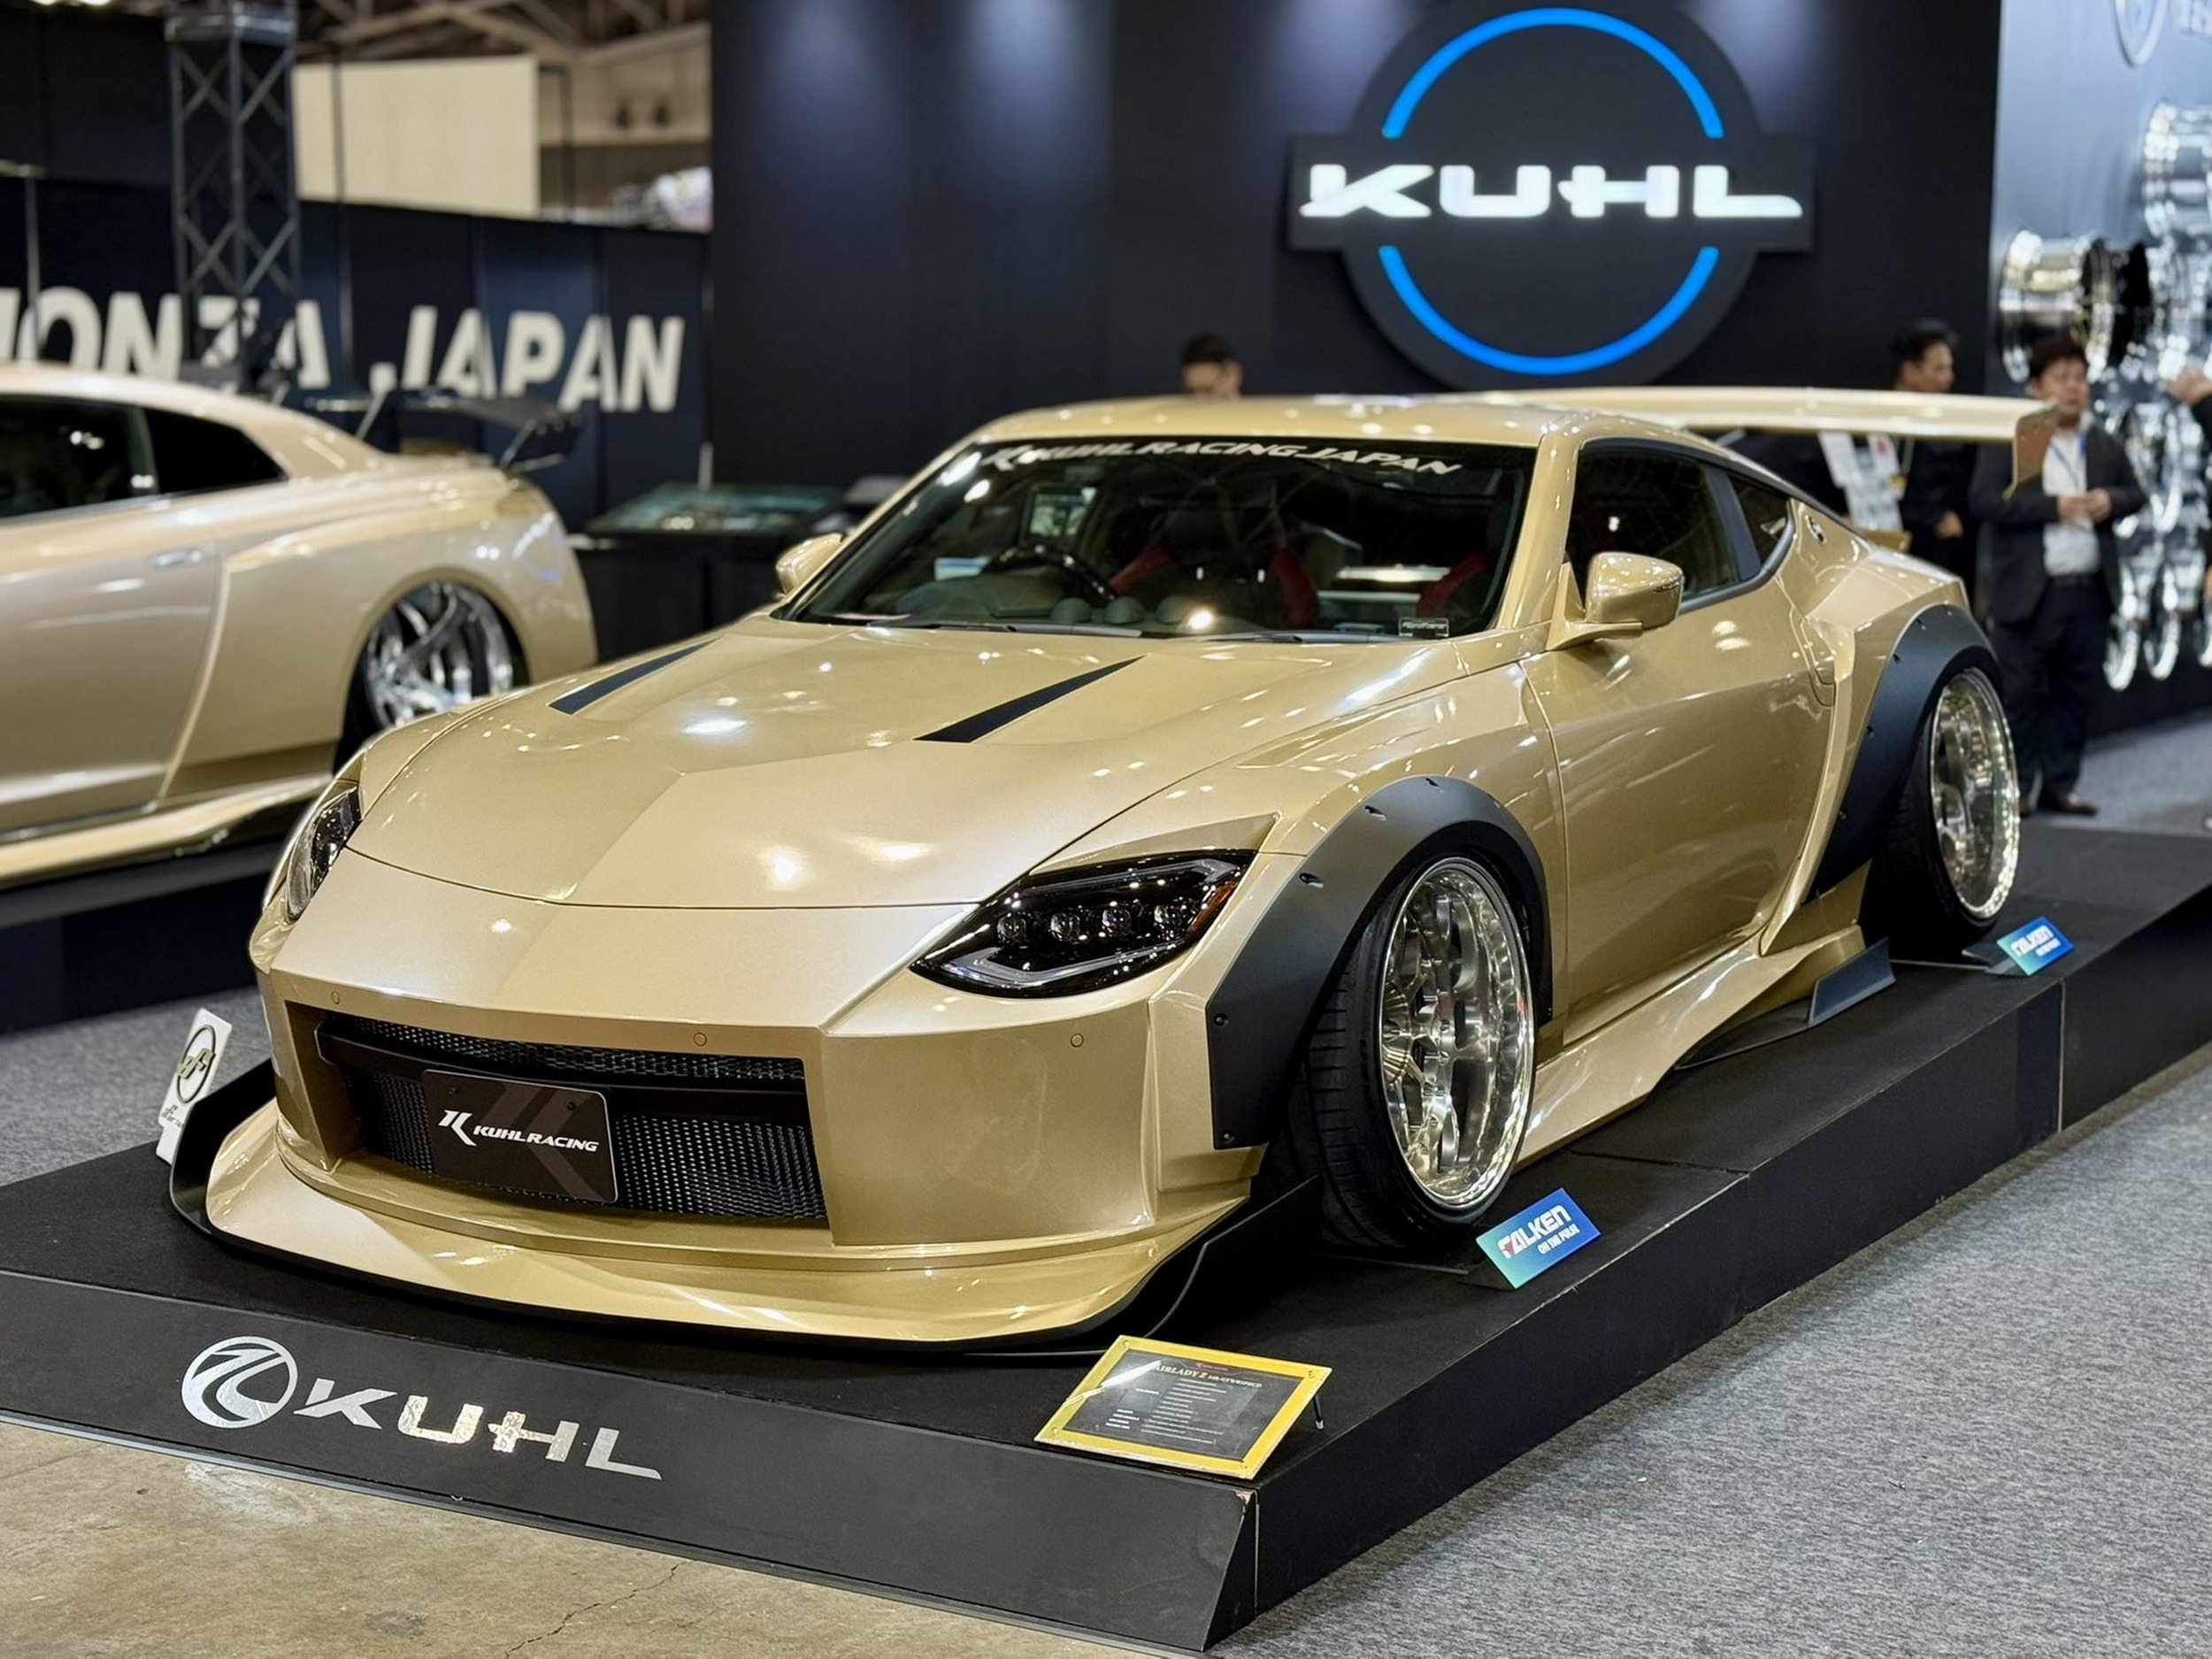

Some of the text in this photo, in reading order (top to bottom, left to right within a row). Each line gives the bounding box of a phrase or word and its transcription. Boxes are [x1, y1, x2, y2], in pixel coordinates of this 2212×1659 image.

[1299, 165, 1803, 219] KUHL
[0, 287, 686, 413] ONZA JAPAN
[1497, 1204, 1572, 1259] FALKEN
[293, 1377, 662, 1480] KUHL
